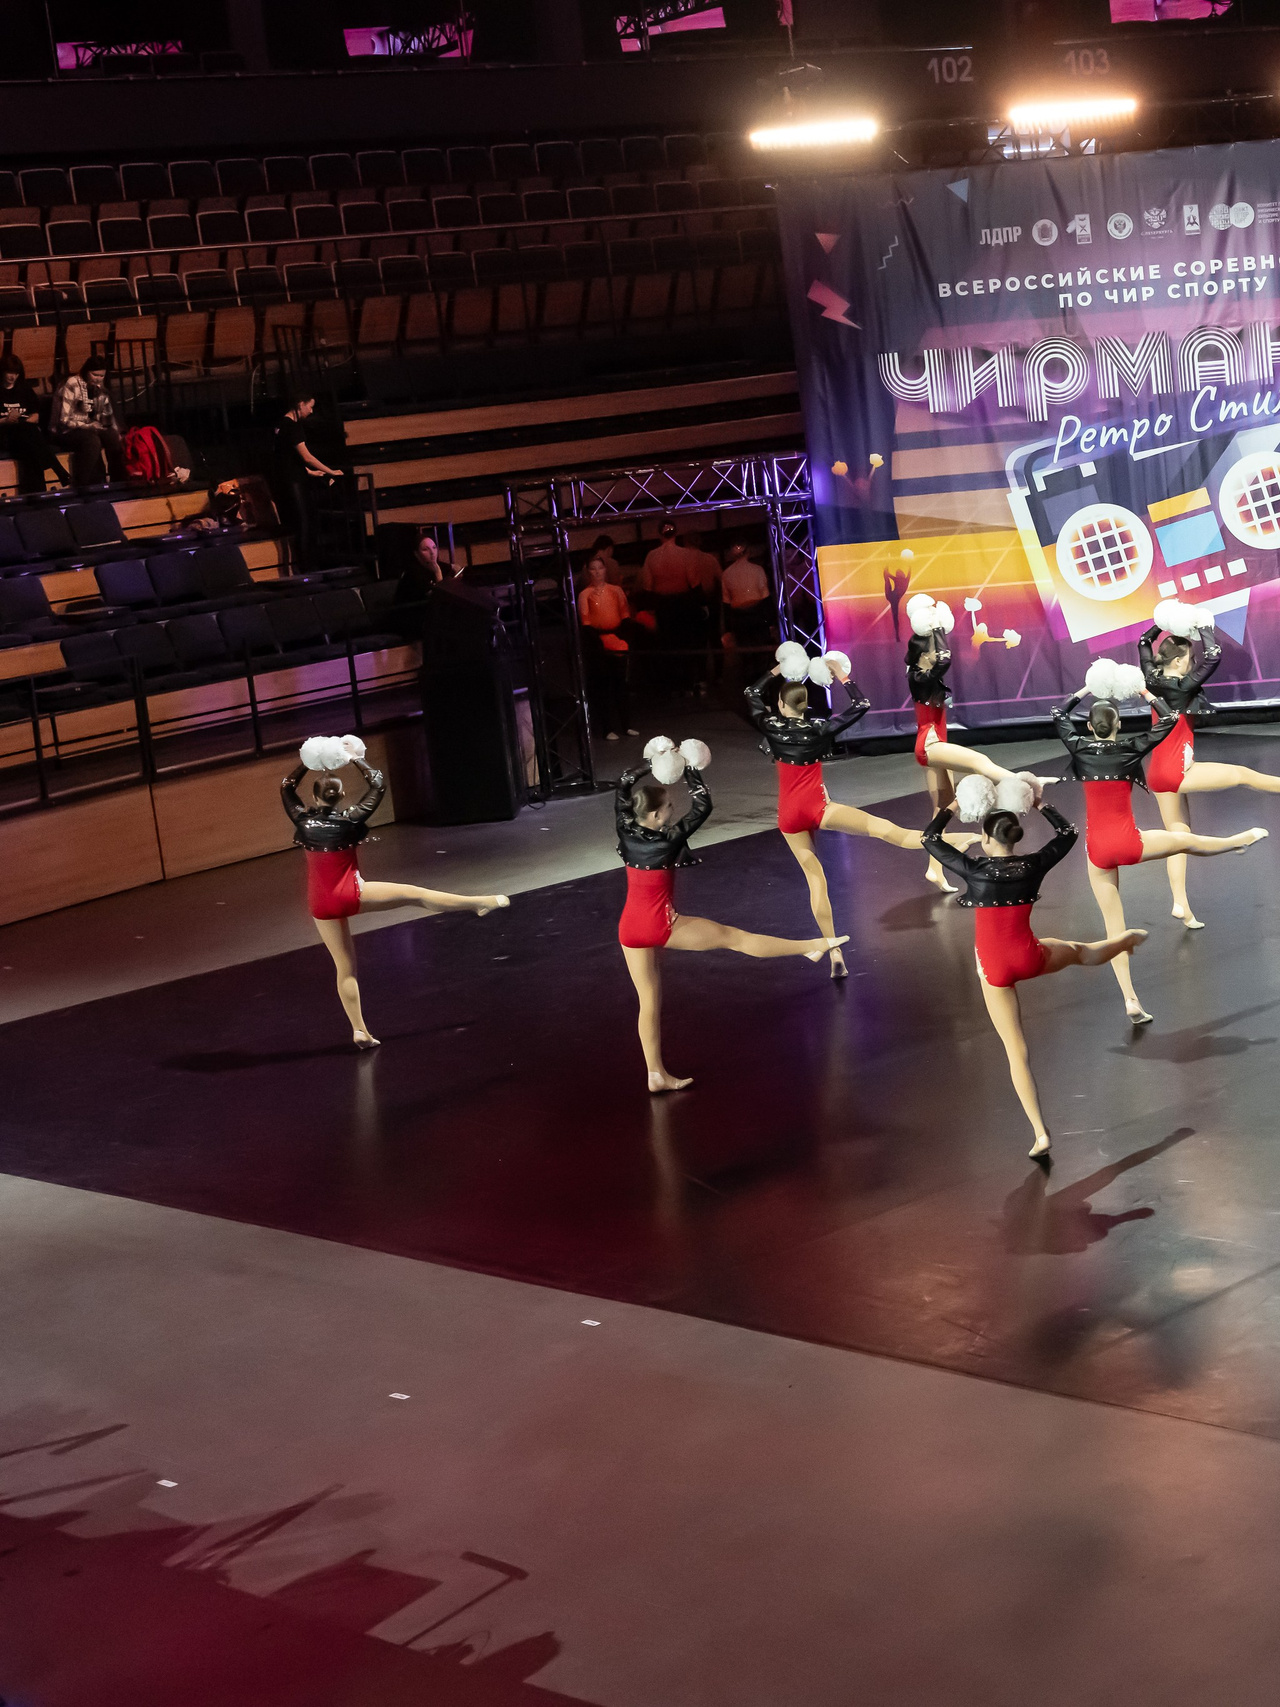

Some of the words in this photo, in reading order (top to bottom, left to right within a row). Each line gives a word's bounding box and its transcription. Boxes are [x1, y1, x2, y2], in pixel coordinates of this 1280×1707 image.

[927, 55, 974, 84] 102
[1064, 48, 1111, 76] 103
[979, 225, 1022, 247] ЛДПР
[937, 263, 1162, 299] ВСЕРОССИЙСКИЕ
[1058, 292, 1093, 309] ПО
[1104, 286, 1155, 306] ЧИР
[1167, 275, 1268, 301] СПОРТУ
[1053, 413, 1173, 464] Ретро
